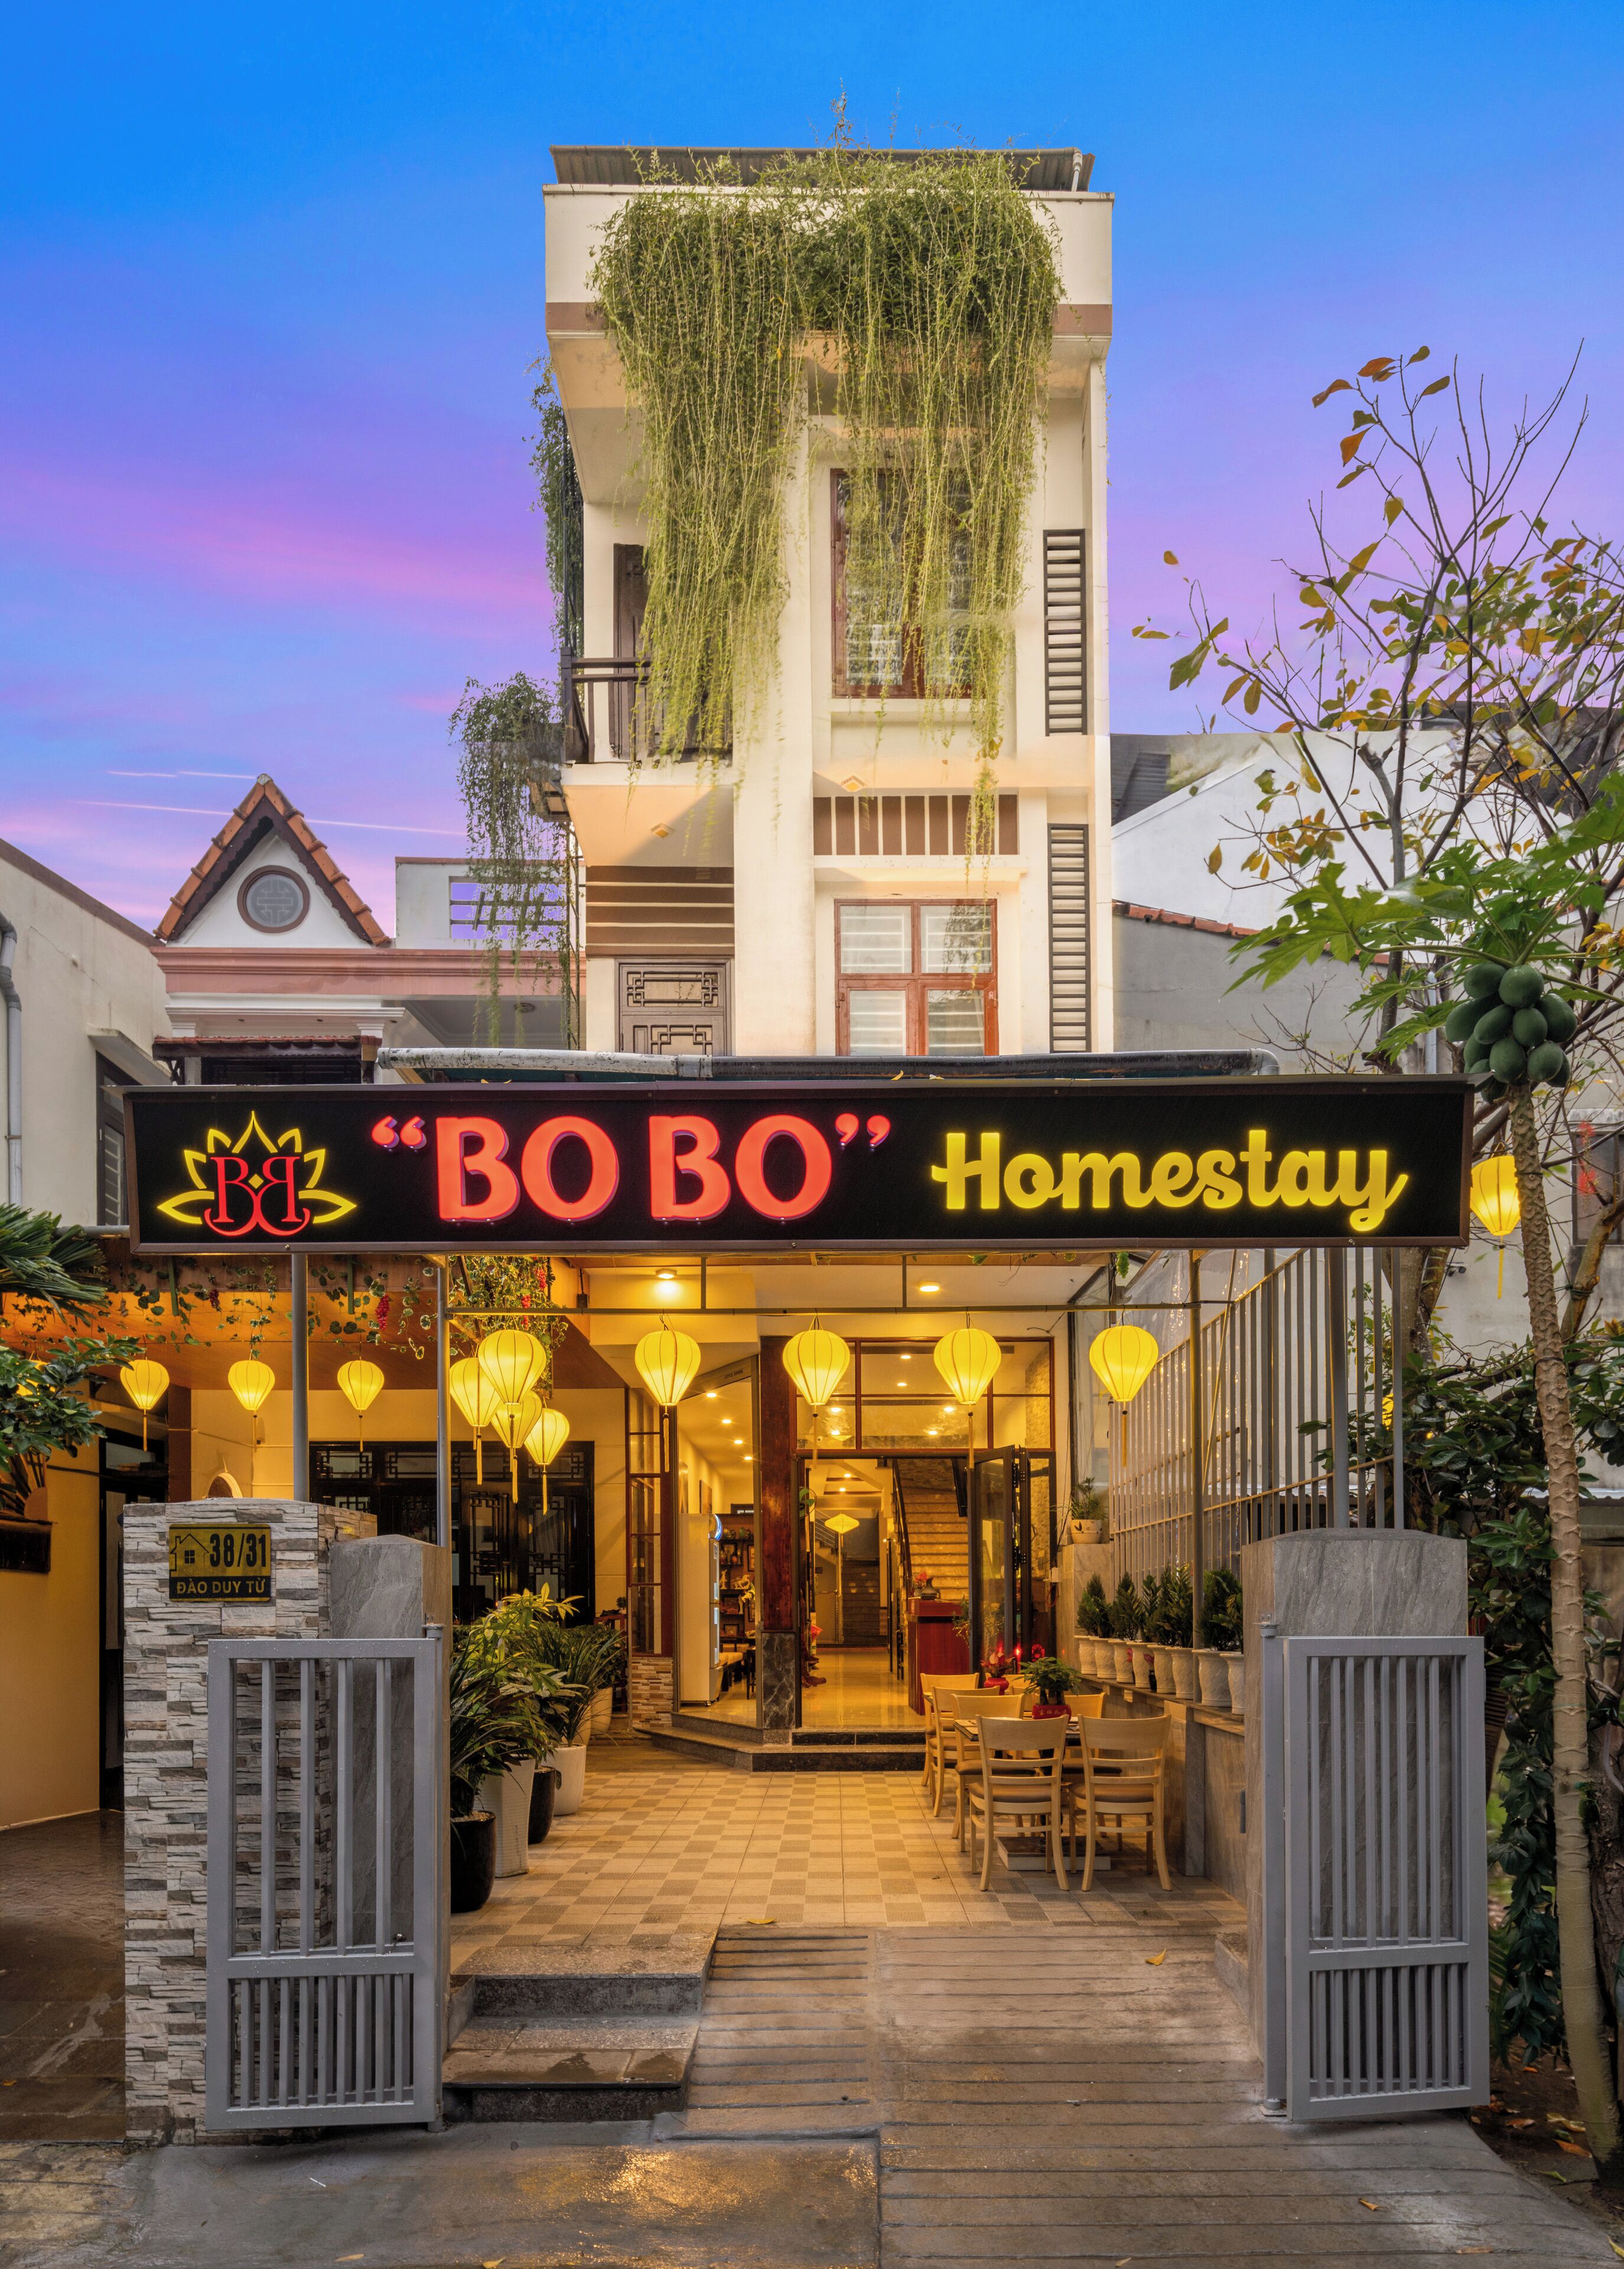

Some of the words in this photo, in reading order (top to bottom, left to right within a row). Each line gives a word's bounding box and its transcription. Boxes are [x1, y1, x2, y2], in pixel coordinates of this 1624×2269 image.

[932, 1130, 1408, 1232] Homestay
[210, 1533, 266, 1567] 38/31
[177, 1578, 207, 1594] ĐÀO
[212, 1581, 241, 1594] DUY
[246, 1577, 265, 1593] TỪ
